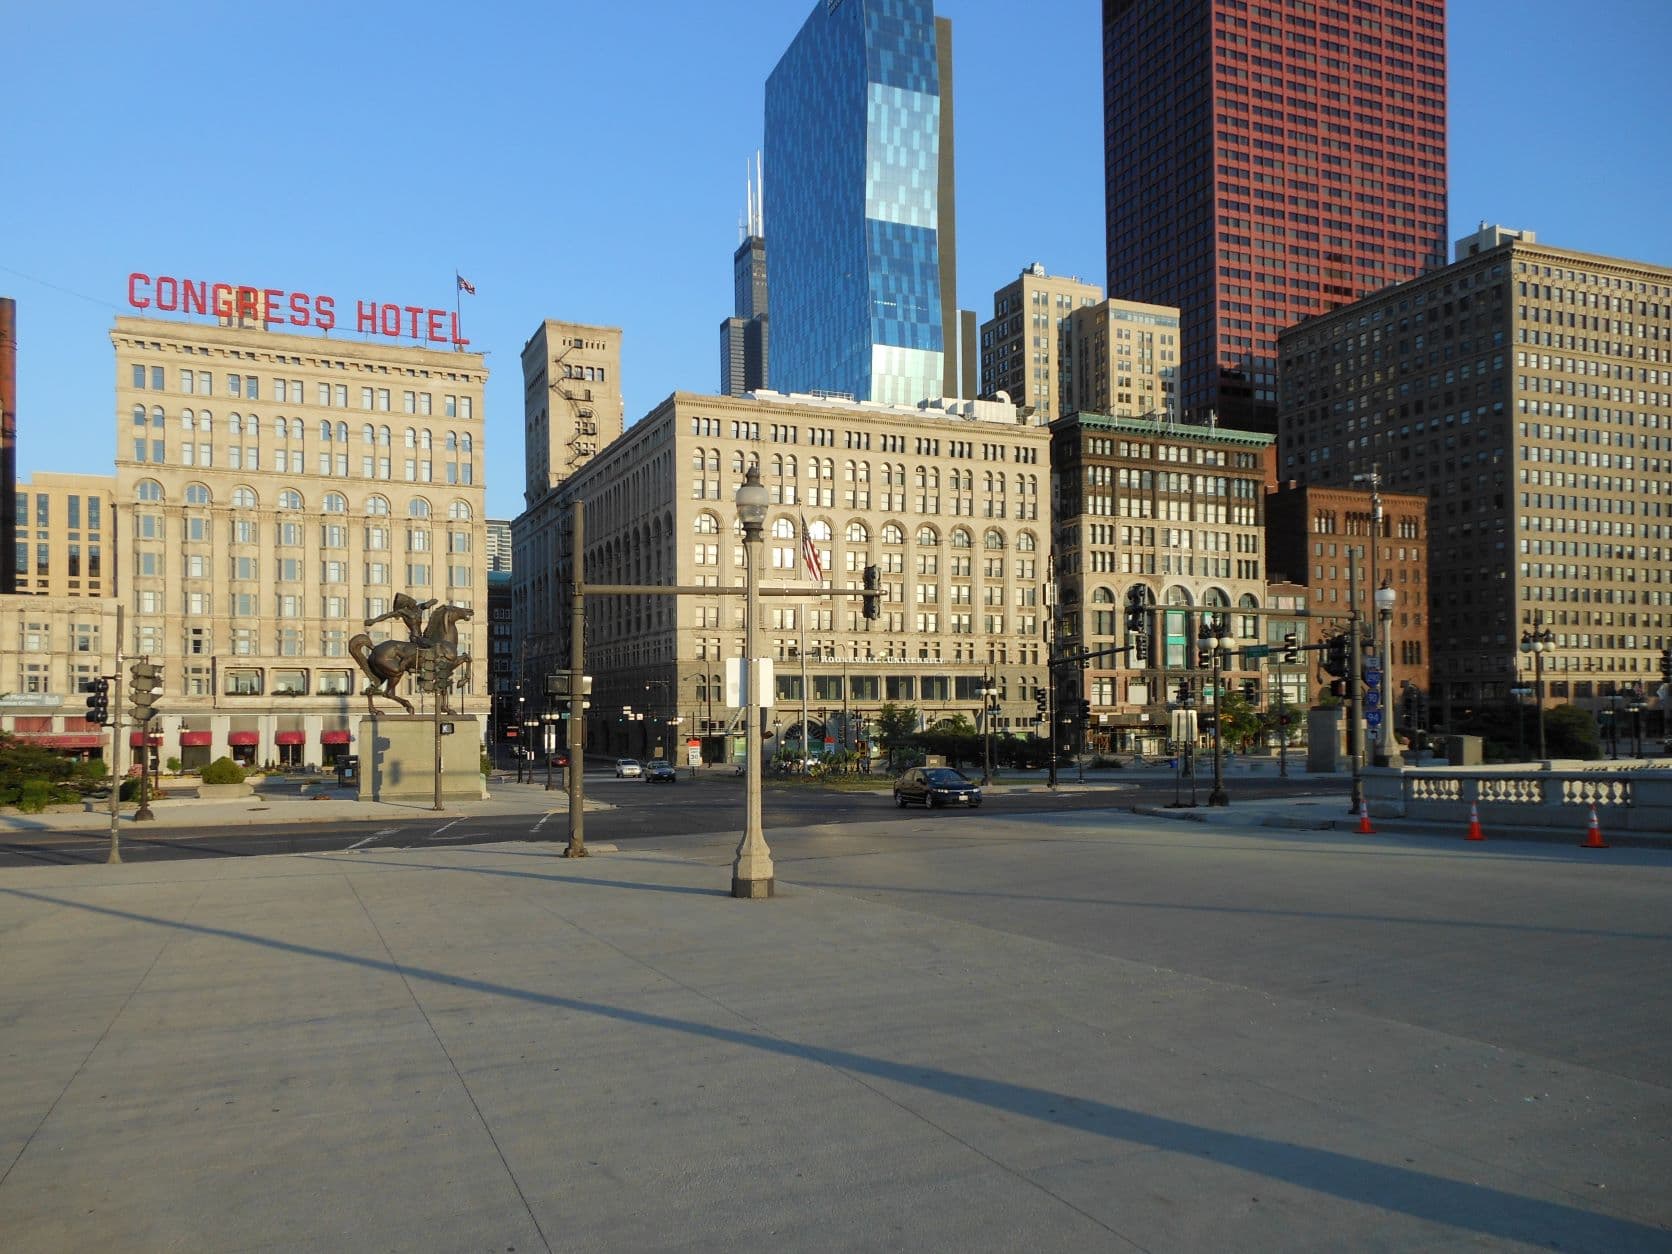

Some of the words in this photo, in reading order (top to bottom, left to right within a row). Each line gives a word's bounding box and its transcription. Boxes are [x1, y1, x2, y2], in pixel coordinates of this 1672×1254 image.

[128, 272, 335, 329] CONGRESS
[357, 300, 470, 345] HOTEL
[887, 656, 944, 664] UNIVERSITY
